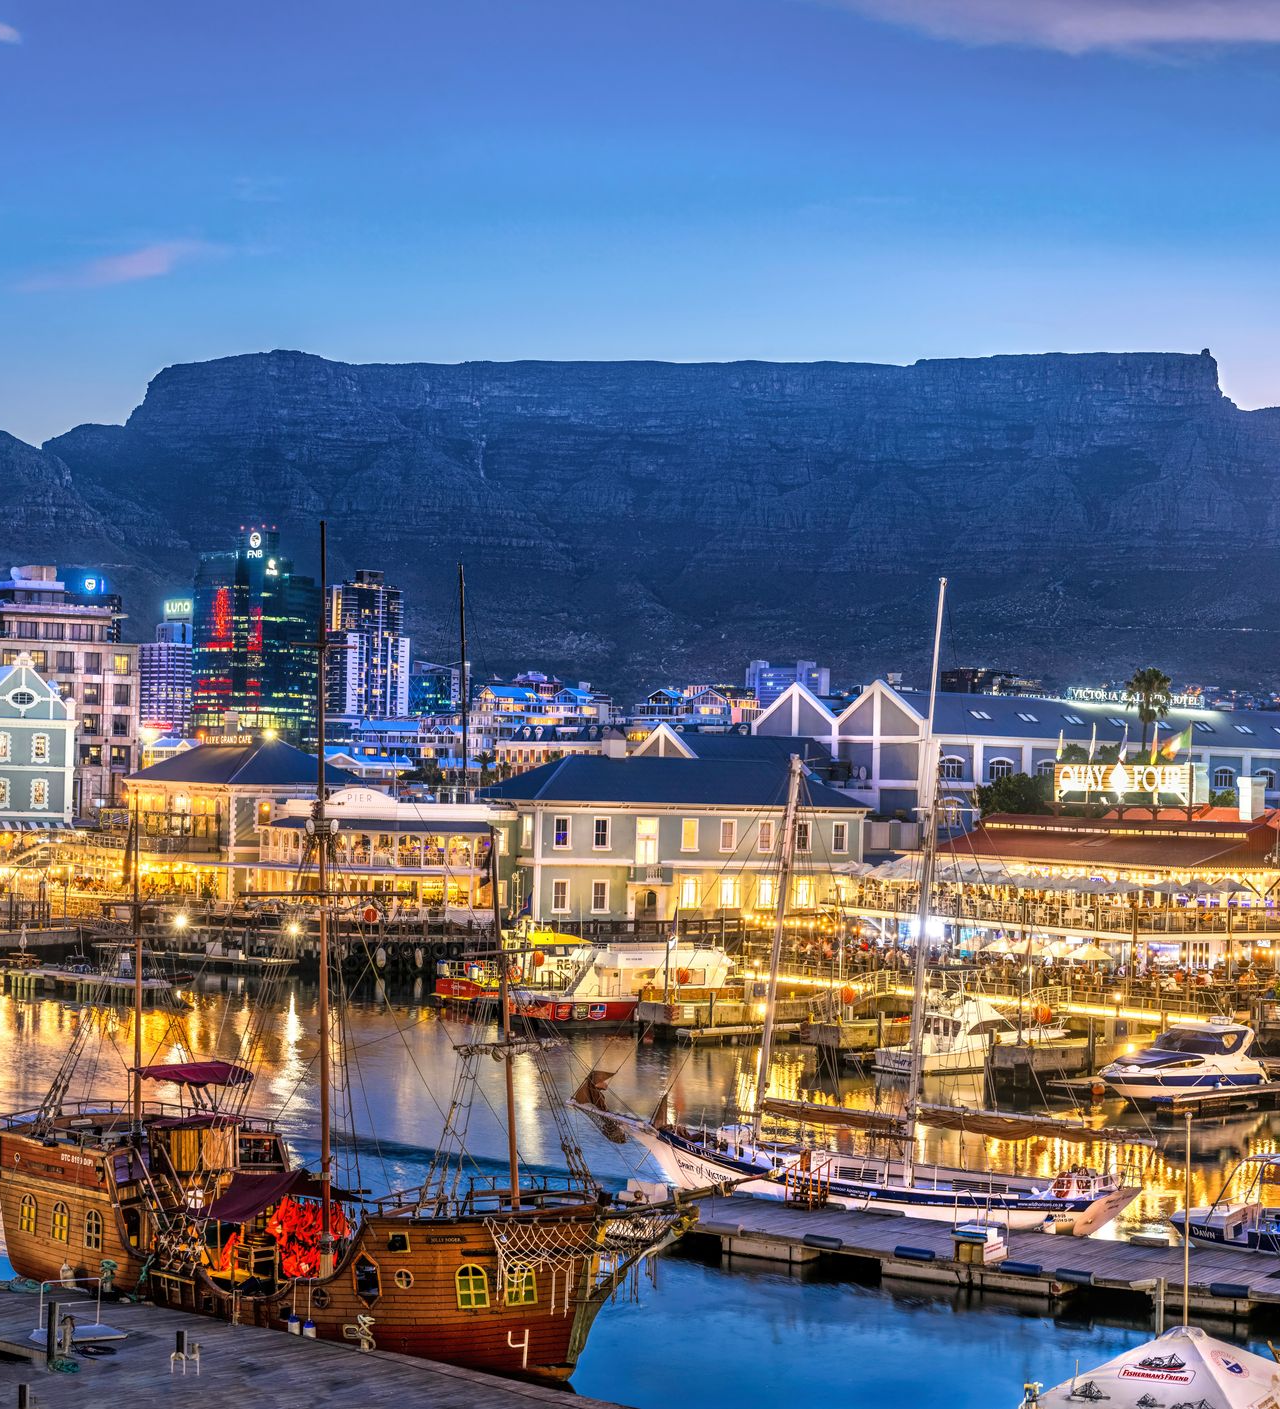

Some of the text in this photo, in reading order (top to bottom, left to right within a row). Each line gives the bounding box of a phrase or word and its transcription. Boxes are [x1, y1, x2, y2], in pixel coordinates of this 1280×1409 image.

[247, 550, 263, 558] FNB
[1073, 690, 1118, 700] VICTORIA
[1170, 694, 1199, 705] HOTEL
[1059, 765, 1183, 792] QUAY FOUR
[347, 794, 372, 802] PIER
[1192, 1226, 1216, 1239] DAWN
[507, 1329, 529, 1369] 4
[1122, 1369, 1189, 1382] FISHERMAN'S FRIEND
